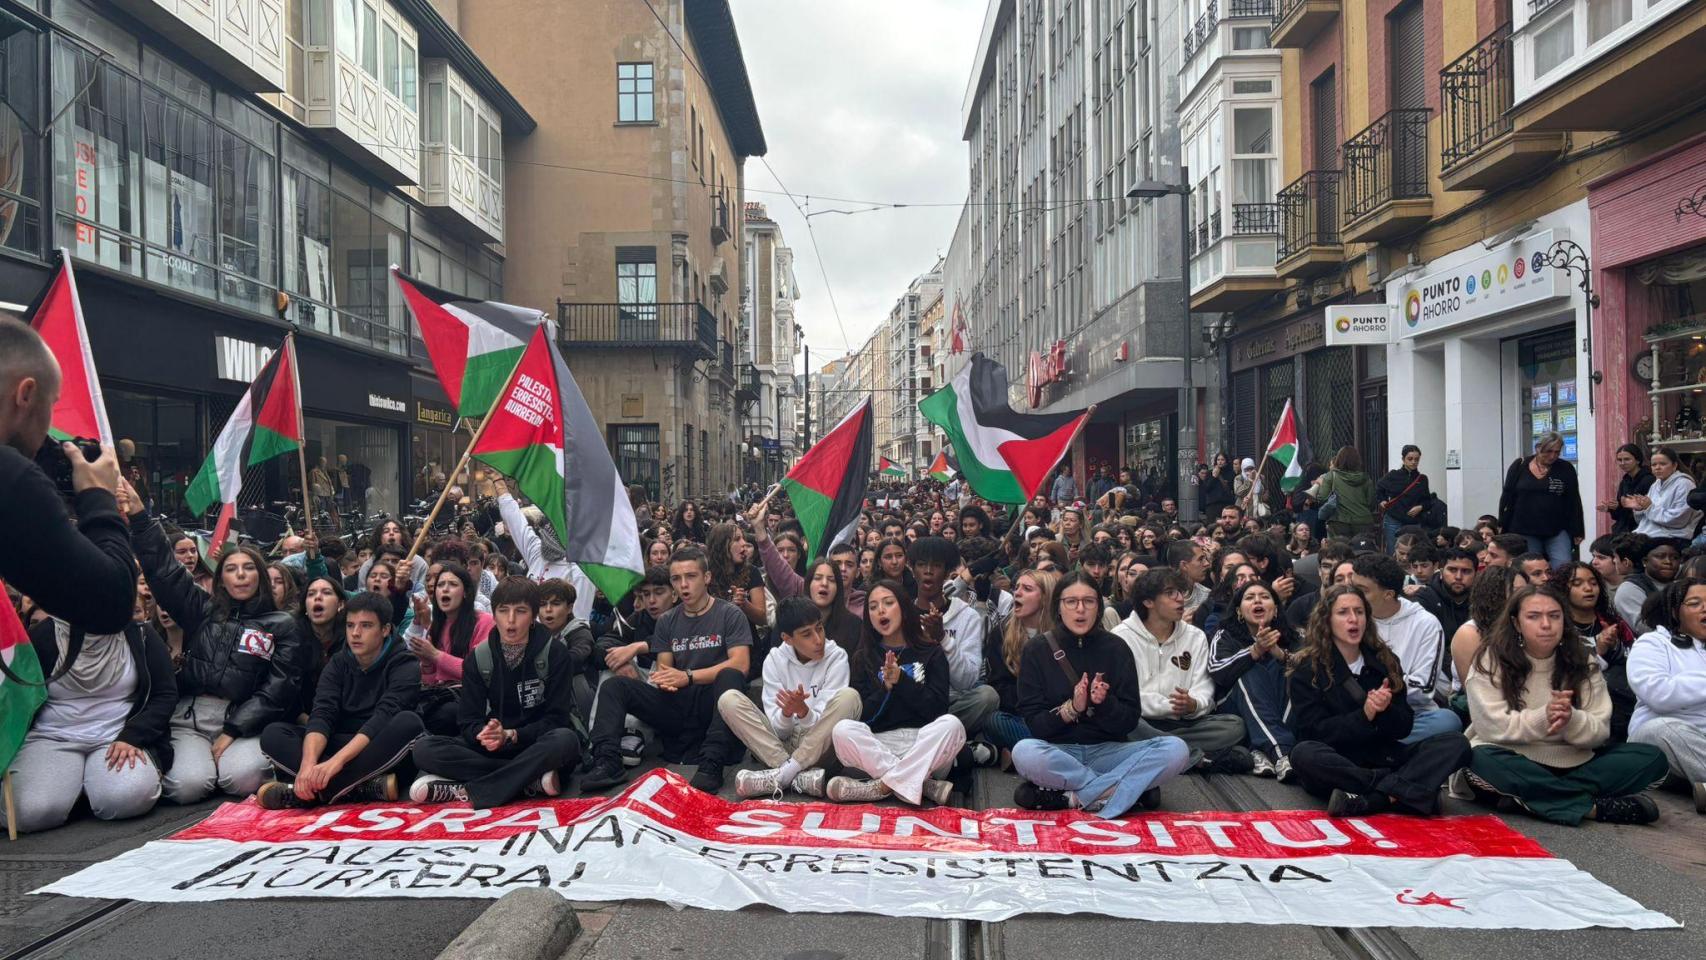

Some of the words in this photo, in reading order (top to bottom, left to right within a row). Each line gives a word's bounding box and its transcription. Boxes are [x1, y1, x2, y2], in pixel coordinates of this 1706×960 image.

[162, 255, 198, 275] ECOALF
[1422, 276, 1461, 302] PUNTO
[1352, 316, 1387, 324] PUNTO
[1423, 296, 1461, 321] AHORRO
[1352, 324, 1387, 332] AHORRO
[417, 401, 452, 426] Langarica
[715, 808, 1399, 849] SUNTSITU!
